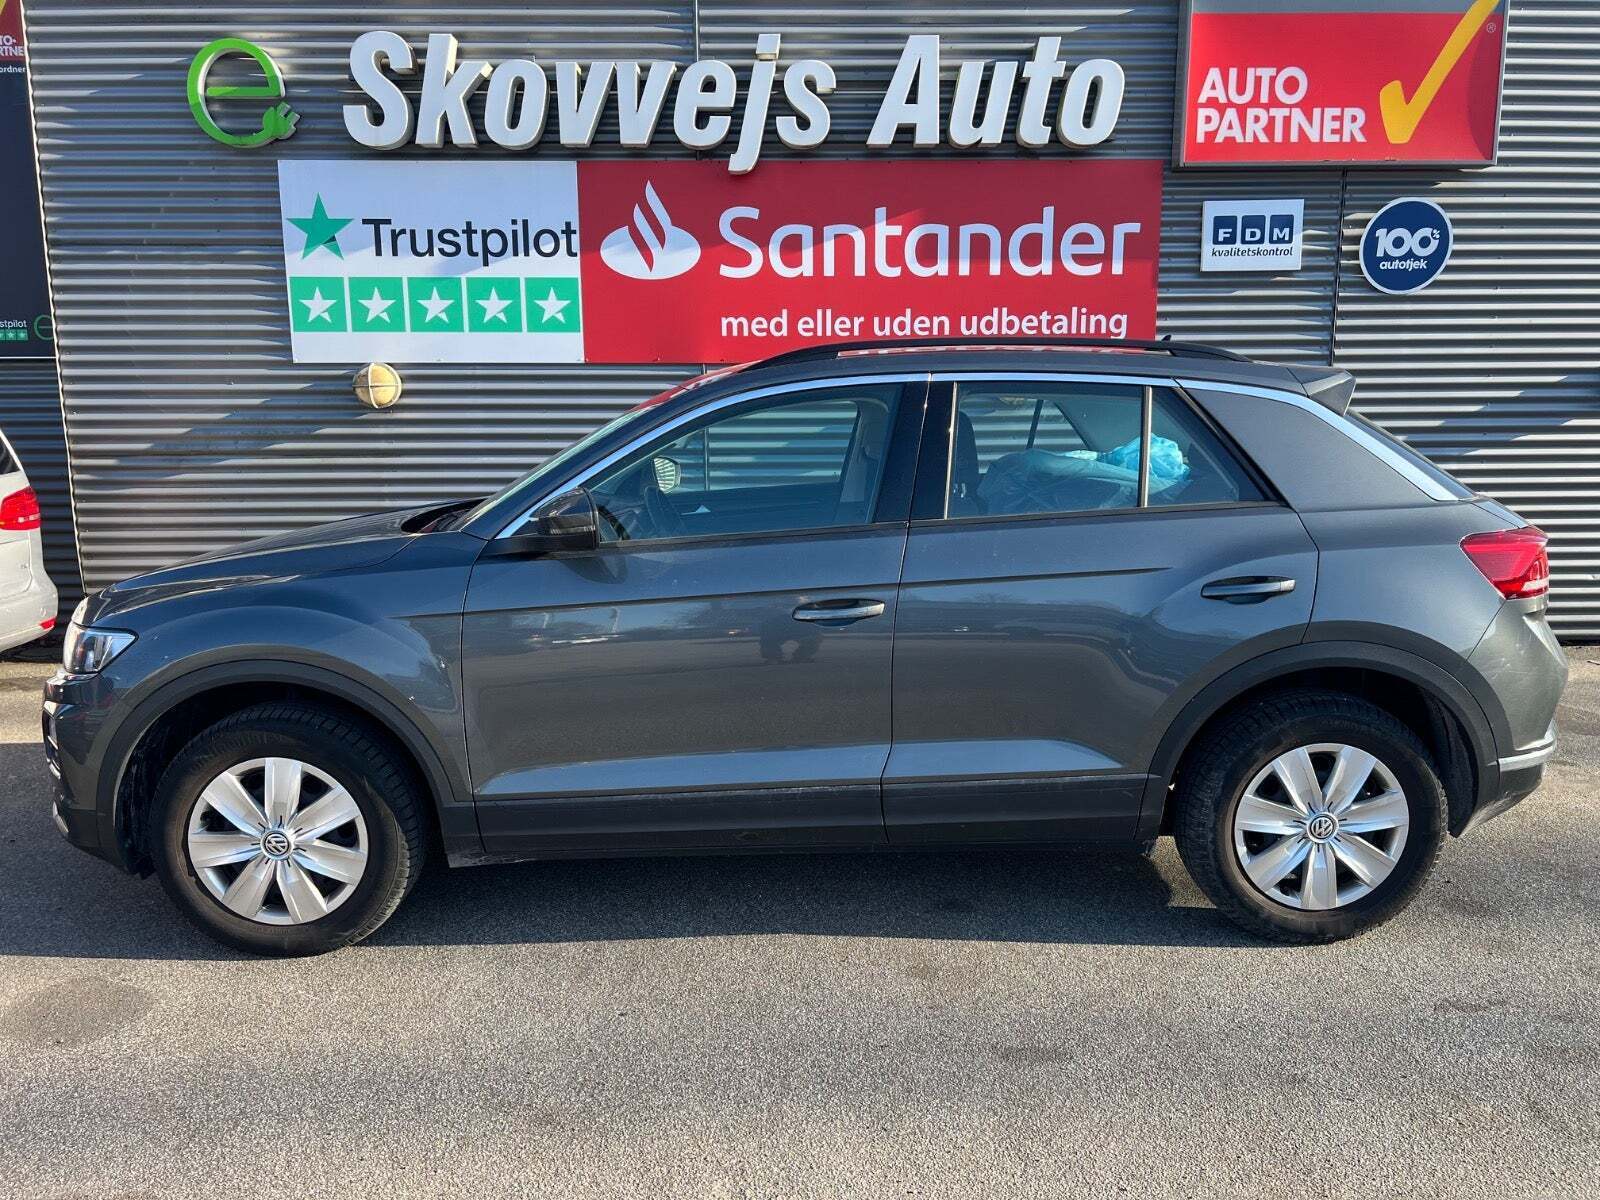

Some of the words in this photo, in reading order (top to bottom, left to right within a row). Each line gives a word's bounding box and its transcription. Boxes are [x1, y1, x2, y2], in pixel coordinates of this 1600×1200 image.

[342, 30, 837, 174] Skovvejs
[866, 34, 1126, 149] Auto
[1197, 66, 1308, 105] AUTO
[1196, 107, 1368, 143] PARTNER
[361, 218, 578, 267] Trustpilot
[718, 206, 1141, 278] Santander
[1211, 247, 1293, 258] kvalitetskontrol
[1379, 259, 1428, 272] autotjek
[720, 308, 788, 337] med
[797, 308, 865, 337] eller
[873, 308, 950, 337] uden
[959, 306, 1128, 340] udbetaling
